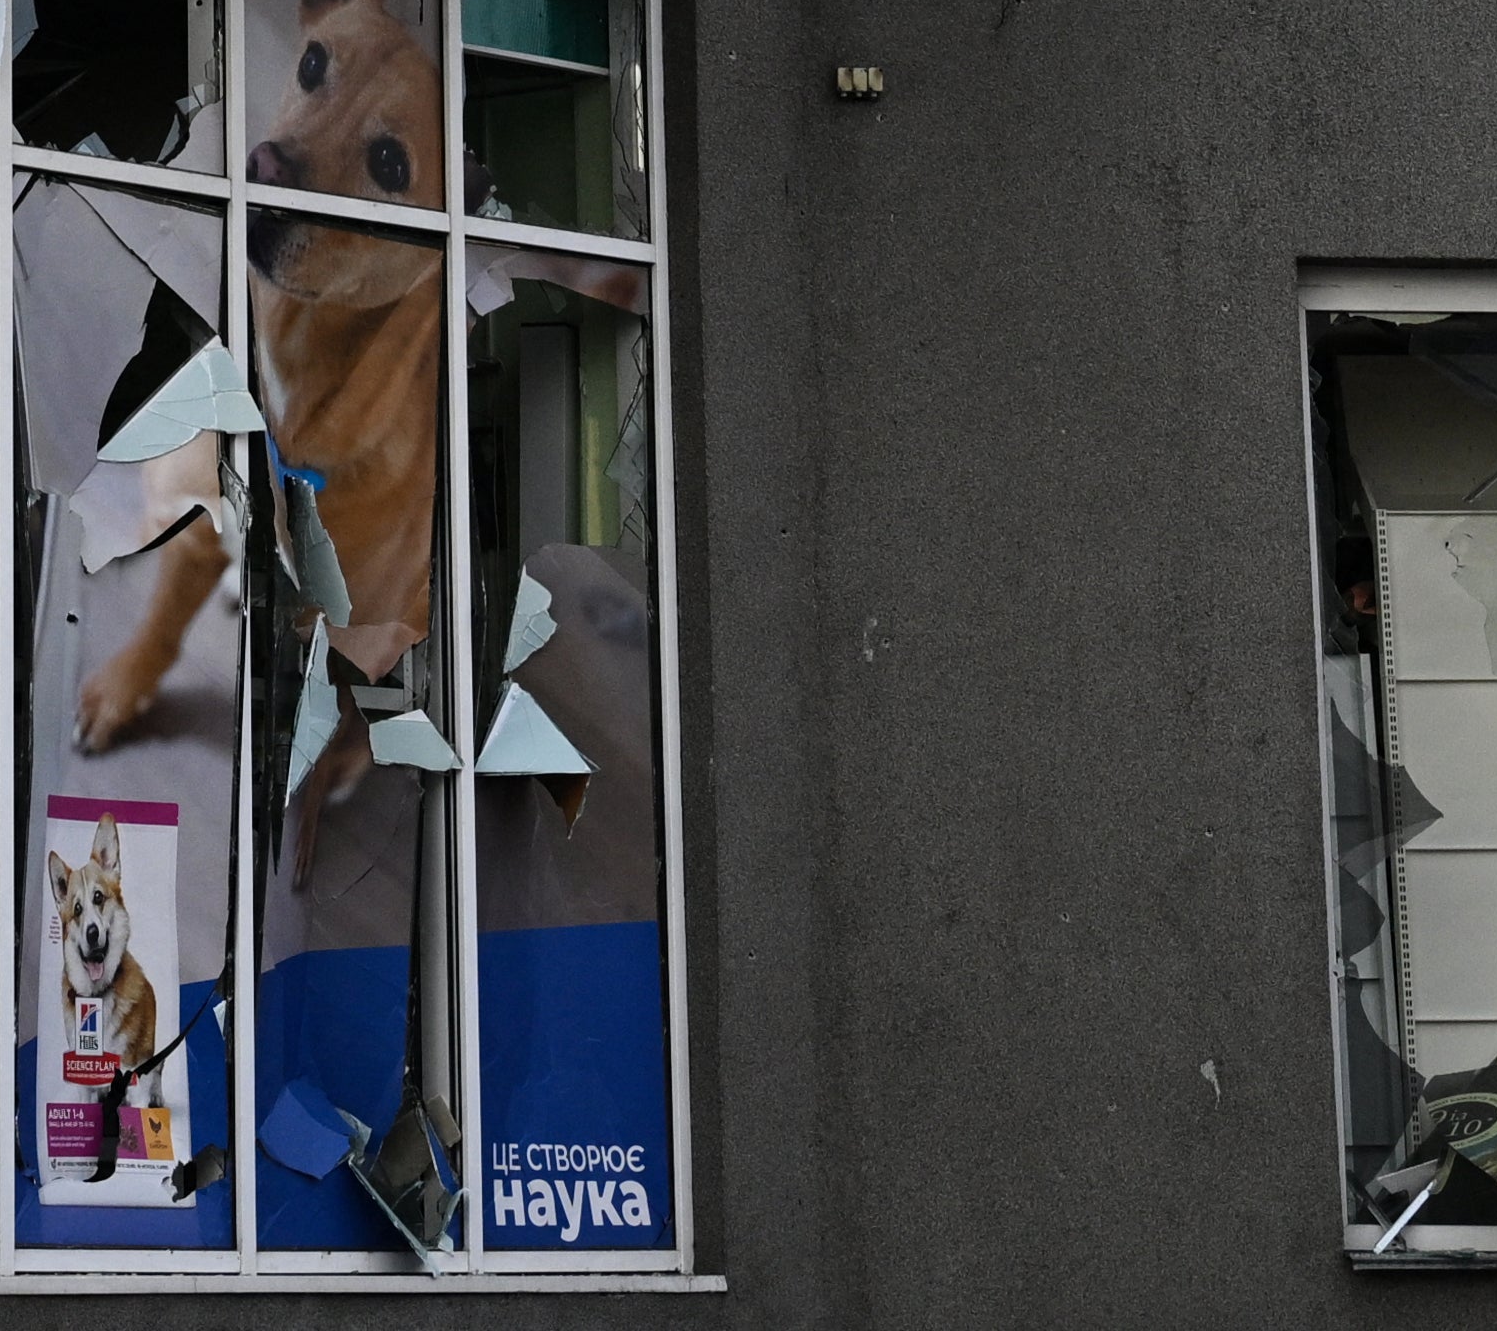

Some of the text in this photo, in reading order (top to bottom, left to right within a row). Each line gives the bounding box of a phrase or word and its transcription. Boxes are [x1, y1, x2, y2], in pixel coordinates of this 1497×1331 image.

[48, 1108, 71, 1120] ADULT
[493, 1143, 646, 1175] ЦЕ СТВОРЮЄ
[493, 1178, 652, 1242] наука
